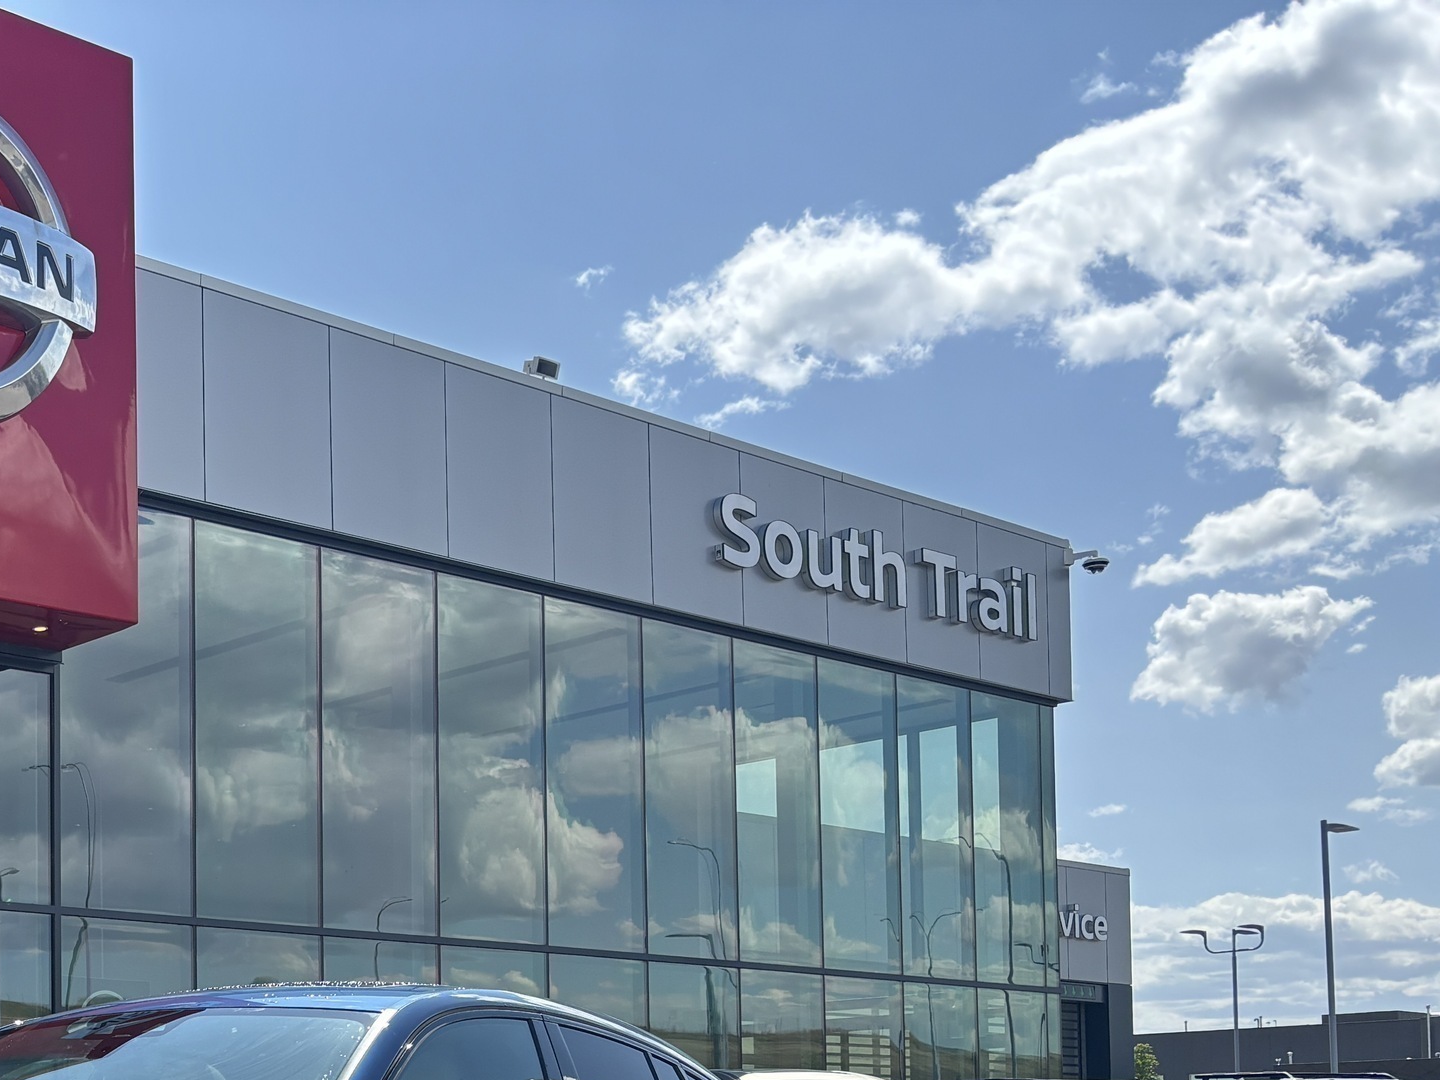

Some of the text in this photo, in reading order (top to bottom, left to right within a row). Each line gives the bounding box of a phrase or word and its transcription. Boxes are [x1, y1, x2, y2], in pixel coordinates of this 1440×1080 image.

[713, 493, 1039, 642] South Trail
[1059, 903, 1108, 941] vice
